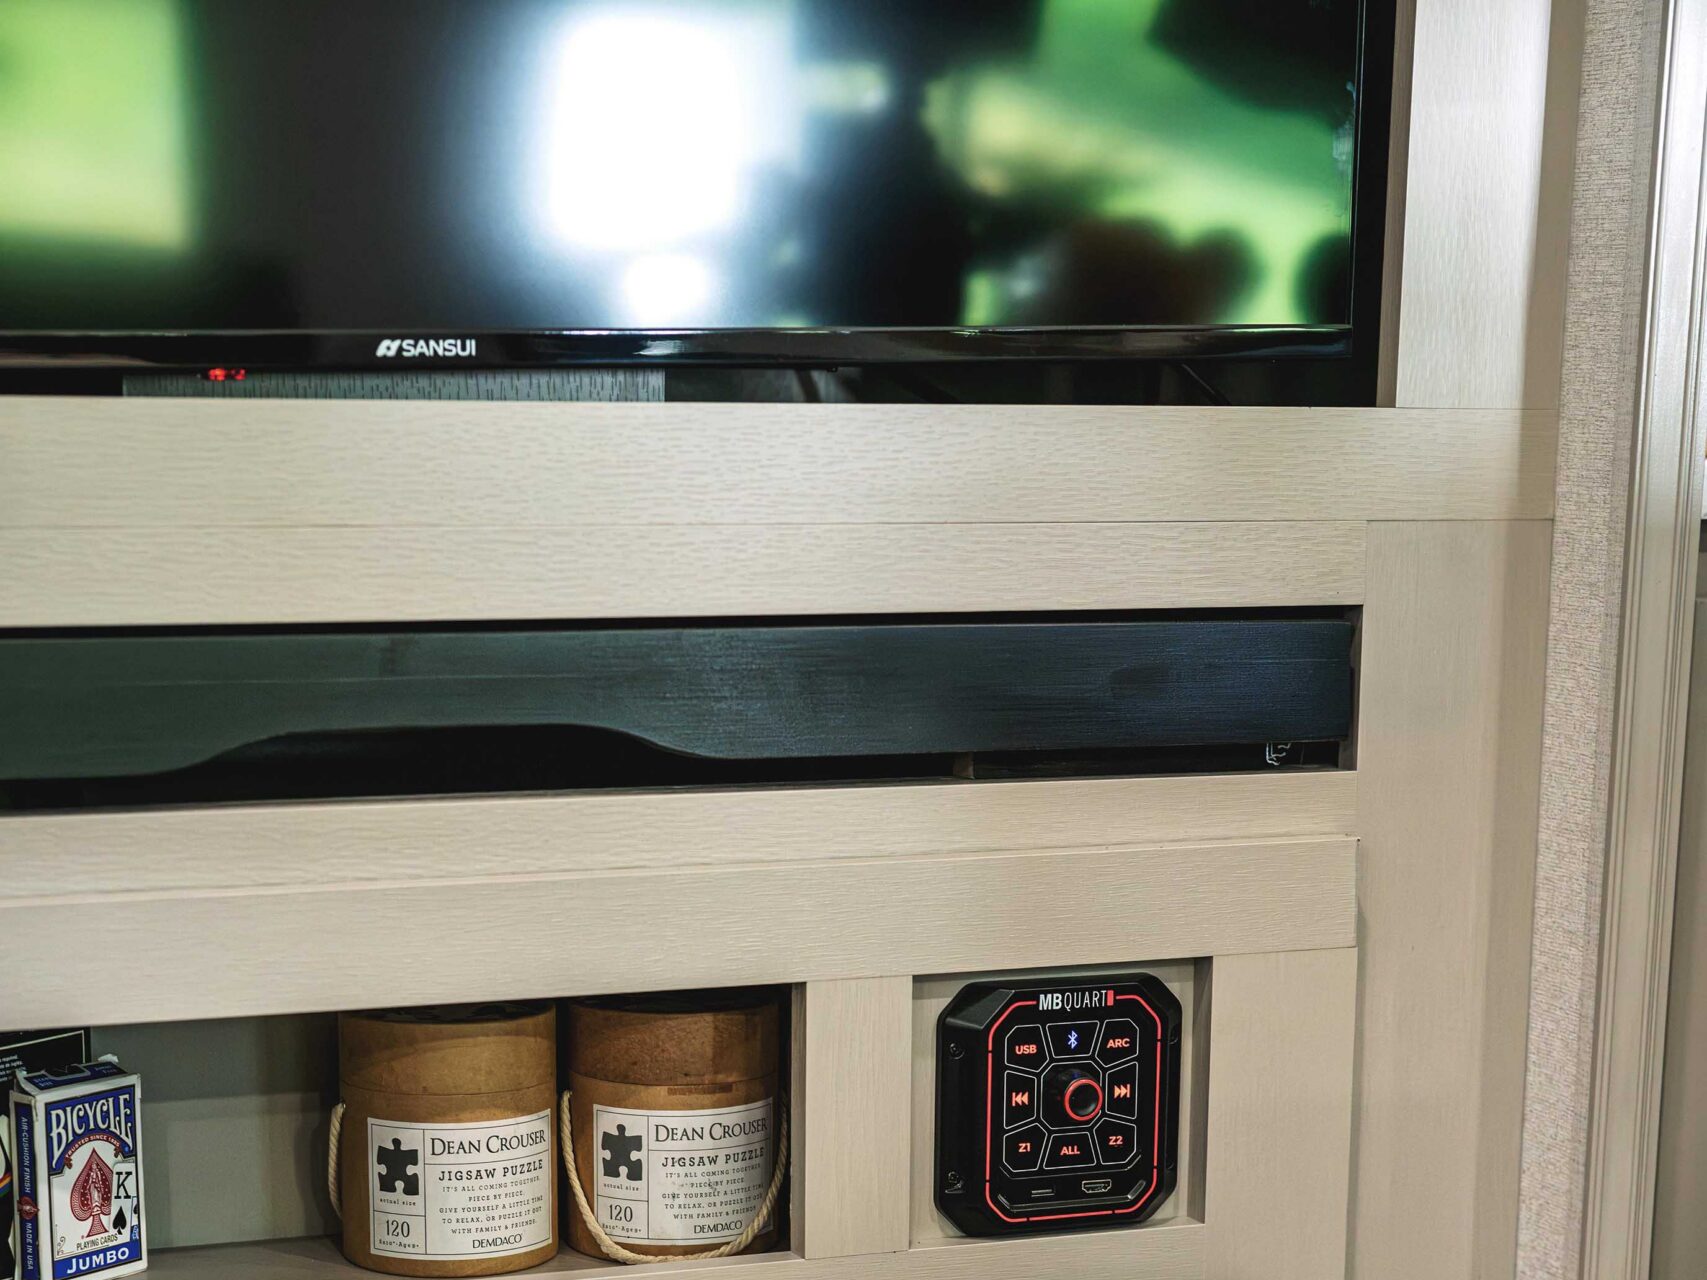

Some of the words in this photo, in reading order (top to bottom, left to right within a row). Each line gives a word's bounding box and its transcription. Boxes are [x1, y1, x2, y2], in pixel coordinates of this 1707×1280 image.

[402, 339, 476, 357] SANSUI
[1015, 1044, 1037, 1054] USB
[1106, 1038, 1131, 1049] ARC
[50, 1094, 133, 1168] BICYCLE
[21, 1117, 30, 1166] AIR-CUSHION
[486, 1129, 546, 1154] CROUSER
[1018, 1142, 1031, 1152] Z1
[1108, 1135, 1123, 1145] Z2
[65, 1137, 90, 1158] TRUSTED
[1060, 1145, 1080, 1156] ALL
[662, 1155, 719, 1167] JIGSAW
[725, 1147, 764, 1164] PUZZLE
[439, 1168, 496, 1181] JIGSAW
[503, 1159, 543, 1177] PUZZLE
[701, 1169, 730, 1177] COMING
[114, 1172, 133, 1199] K
[479, 1183, 507, 1191] COMING
[730, 1186, 751, 1195] LITTLE
[468, 1194, 490, 1202] PIECE
[720, 1198, 743, 1206] PUZZLE
[461, 1204, 499, 1213] YOURSELF
[509, 1199, 530, 1209] LITTLE
[609, 1204, 633, 1222] 120
[498, 1211, 522, 1220] PUZZLE
[697, 1211, 722, 1219] FAMILY
[25, 1222, 33, 1243] MADE
[386, 1219, 410, 1238] 120
[475, 1225, 502, 1233] FAMILY
[694, 1220, 743, 1234] DEMDACO
[76, 1238, 100, 1251] PLAYING
[100, 1233, 118, 1245] CARDS
[472, 1234, 522, 1248] DEMDACO
[26, 1245, 33, 1254] IN
[26, 1255, 34, 1270] USA
[67, 1247, 130, 1274] JUMBO
